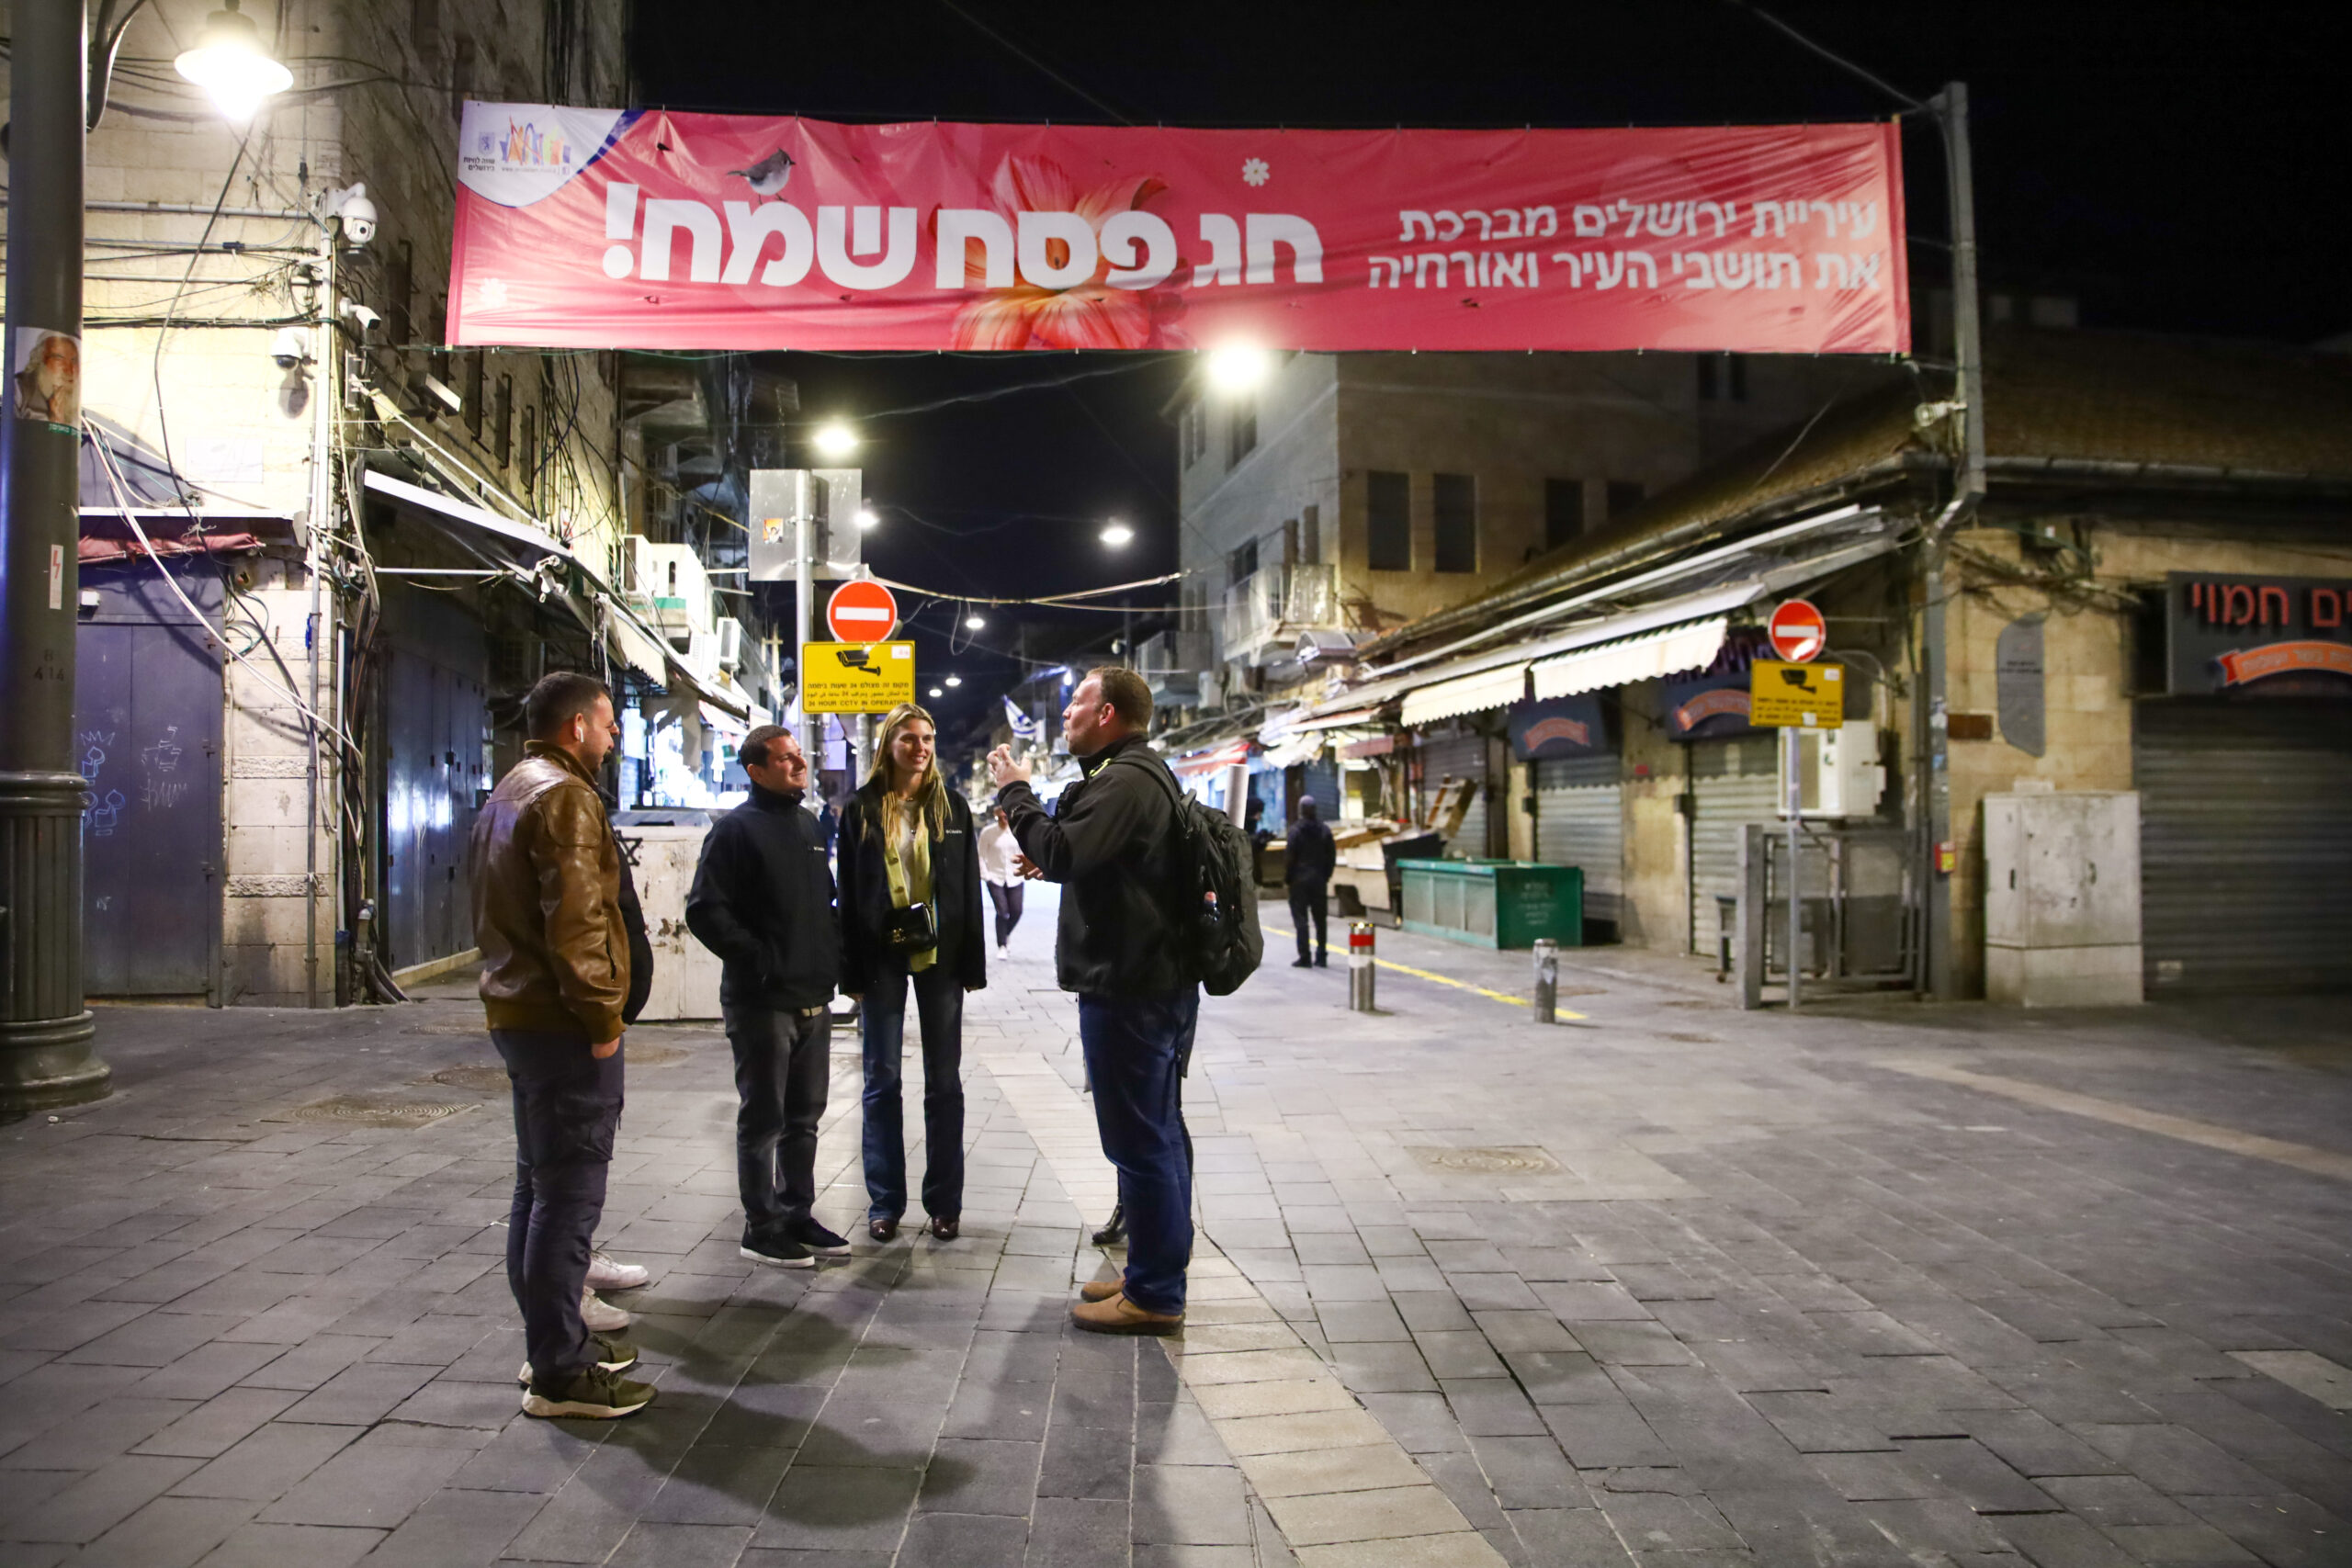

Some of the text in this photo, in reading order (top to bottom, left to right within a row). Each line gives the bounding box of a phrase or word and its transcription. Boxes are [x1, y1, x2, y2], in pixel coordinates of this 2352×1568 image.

[602, 181, 1323, 290] חג פסח שמח!
[1399, 197, 1877, 242] עיריית ירושלים מברכת
[1368, 251, 1882, 291] את תושבי העיר ואורחיה
[2192, 582, 2290, 626] חמוי
